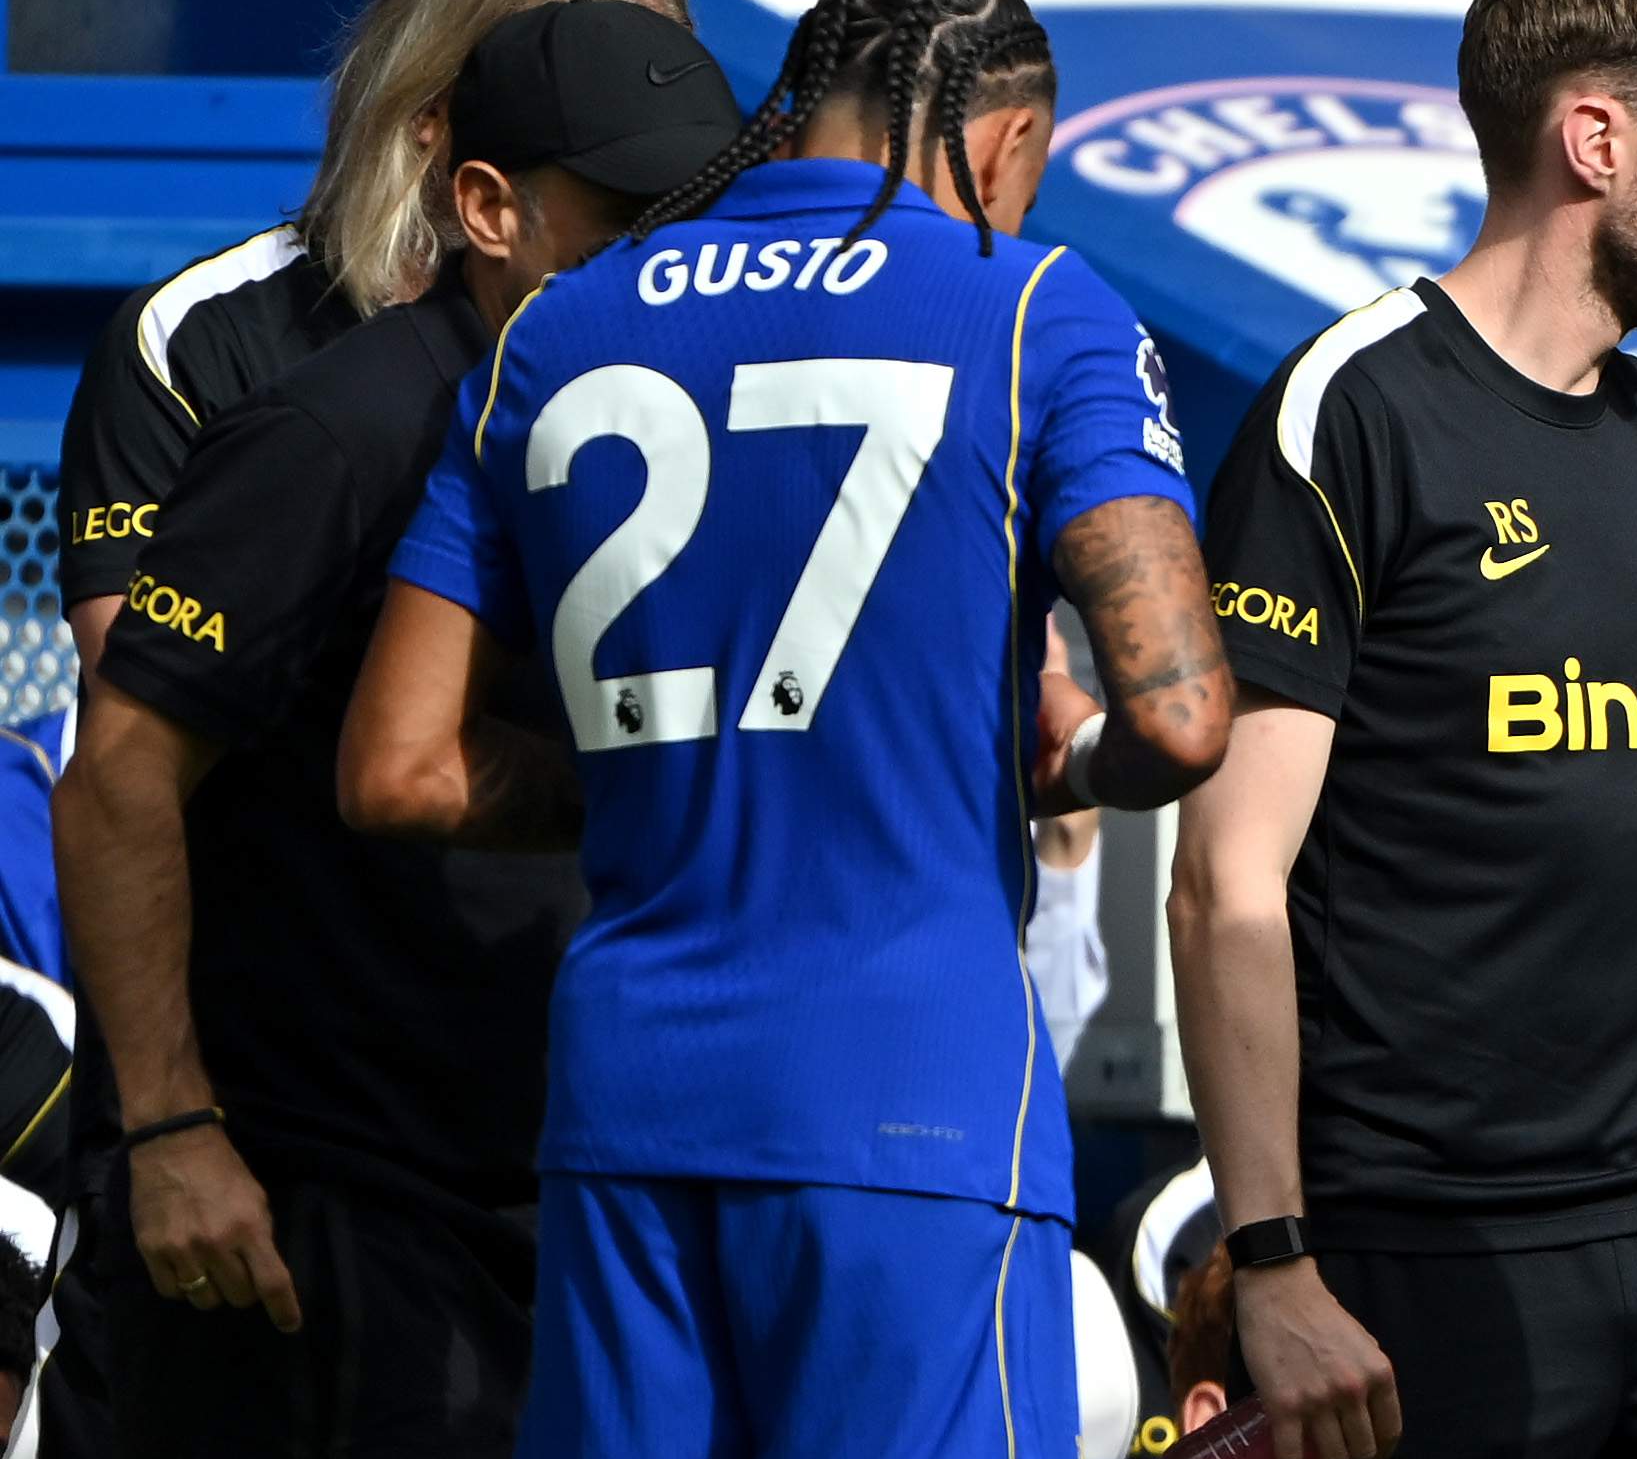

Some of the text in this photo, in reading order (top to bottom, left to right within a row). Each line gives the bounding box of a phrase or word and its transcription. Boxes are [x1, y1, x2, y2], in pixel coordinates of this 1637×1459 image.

[637, 237, 889, 306] GUSTO
[525, 357, 956, 753] 27
[1484, 498, 1540, 545] RS
[127, 570, 225, 653] GORA
